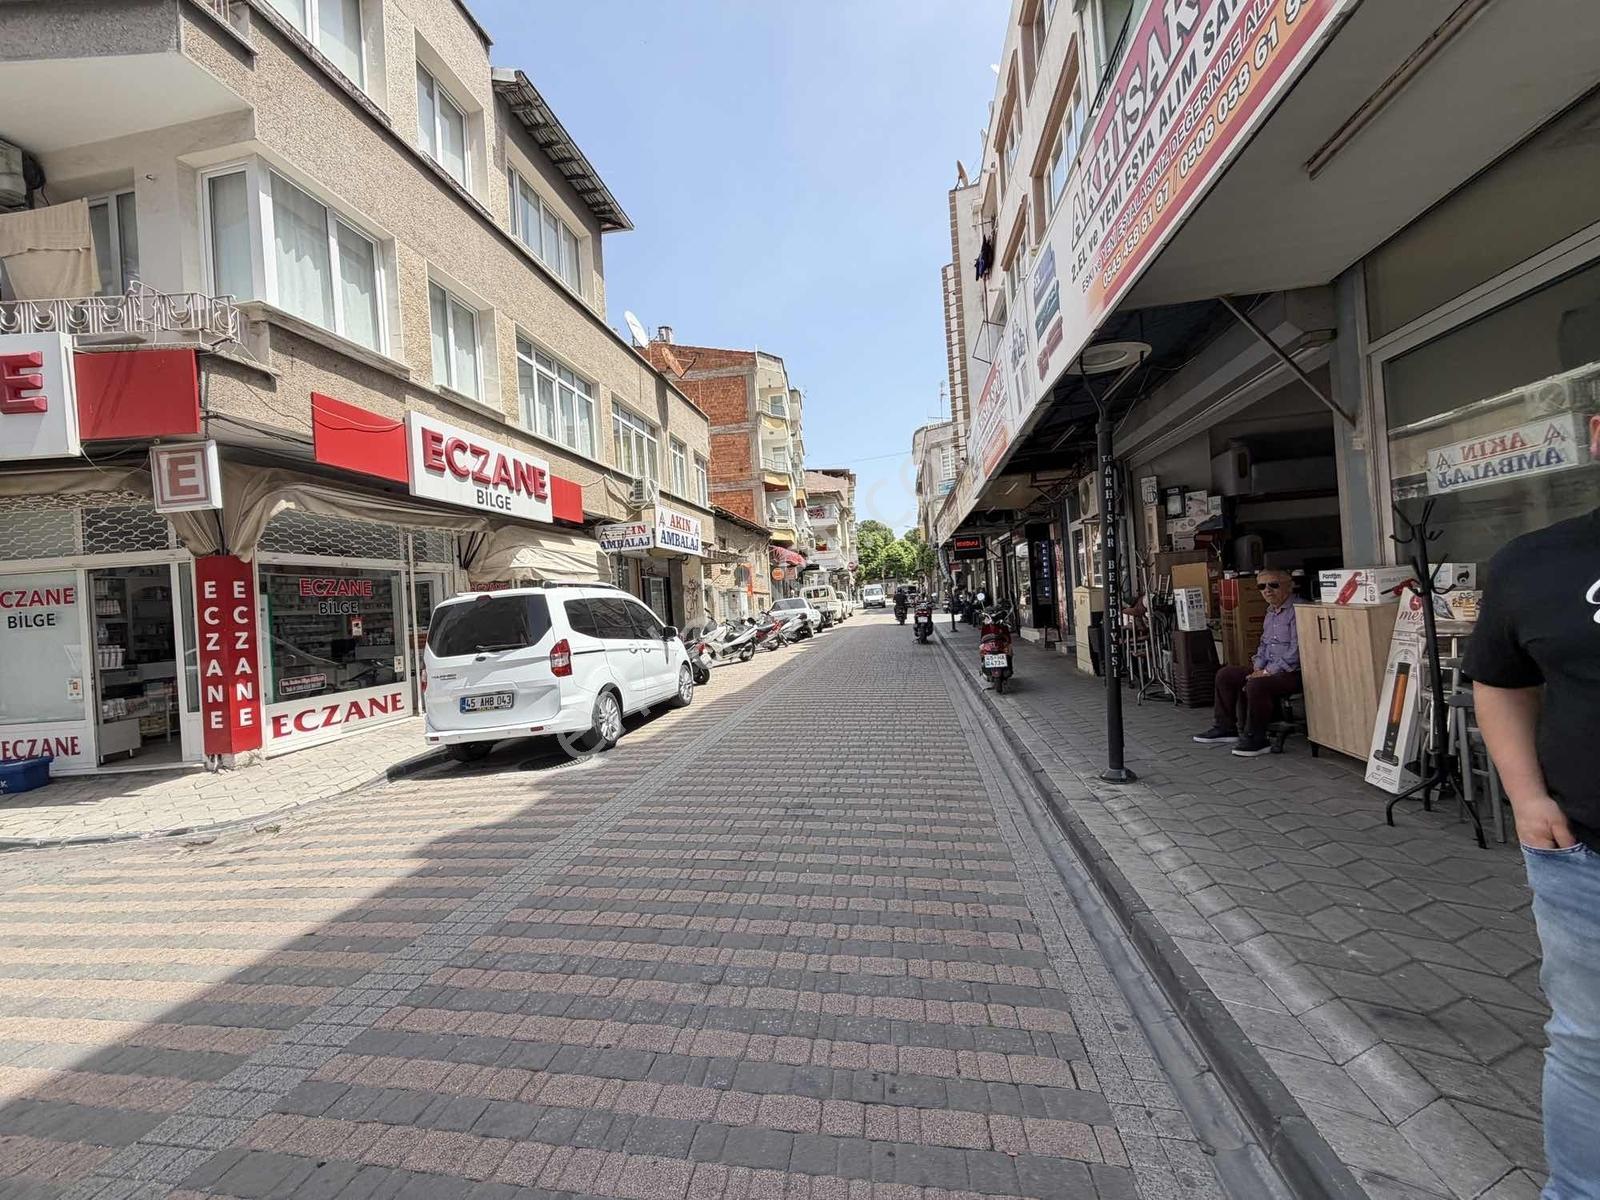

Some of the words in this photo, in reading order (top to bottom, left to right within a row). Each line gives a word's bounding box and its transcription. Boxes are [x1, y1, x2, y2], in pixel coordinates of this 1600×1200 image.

[1169, 28, 1242, 160] DEĞERİNDE
[1243, 0, 1272, 48] AL
[1179, 114, 1215, 179] 0506
[1217, 61, 1250, 124] 058
[1253, 16, 1280, 70] 61
[1071, 247, 1088, 283] 2.EL
[1089, 229, 1099, 253] ve
[1100, 178, 1122, 233] YENİ
[1125, 128, 1155, 191] EŞYA
[1158, 48, 1198, 137] ALIM
[1203, 0, 1238, 57] SA
[168, 456, 200, 497] E
[421, 426, 549, 501] ECZANE
[476, 487, 512, 511] BİLGE
[1104, 465, 1115, 548] AKHİSAR
[600, 536, 650, 550] AMBALAJ
[660, 529, 699, 551] AMBALAJ
[670, 514, 691, 532] AKIN
[299, 577, 373, 597] ECZANE
[319, 598, 359, 615] BİLGE
[8, 611, 56, 629] BİLGE
[1107, 560, 1118, 678] BELEDİYESİ
[204, 581, 224, 729] ECZANE
[232, 581, 254, 727] ECZANE
[271, 692, 405, 739] ECZANE
[466, 698, 476, 708] 45
[480, 696, 494, 707] AHB
[496, 695, 512, 706] 043
[1, 736, 81, 761] ECZANE
